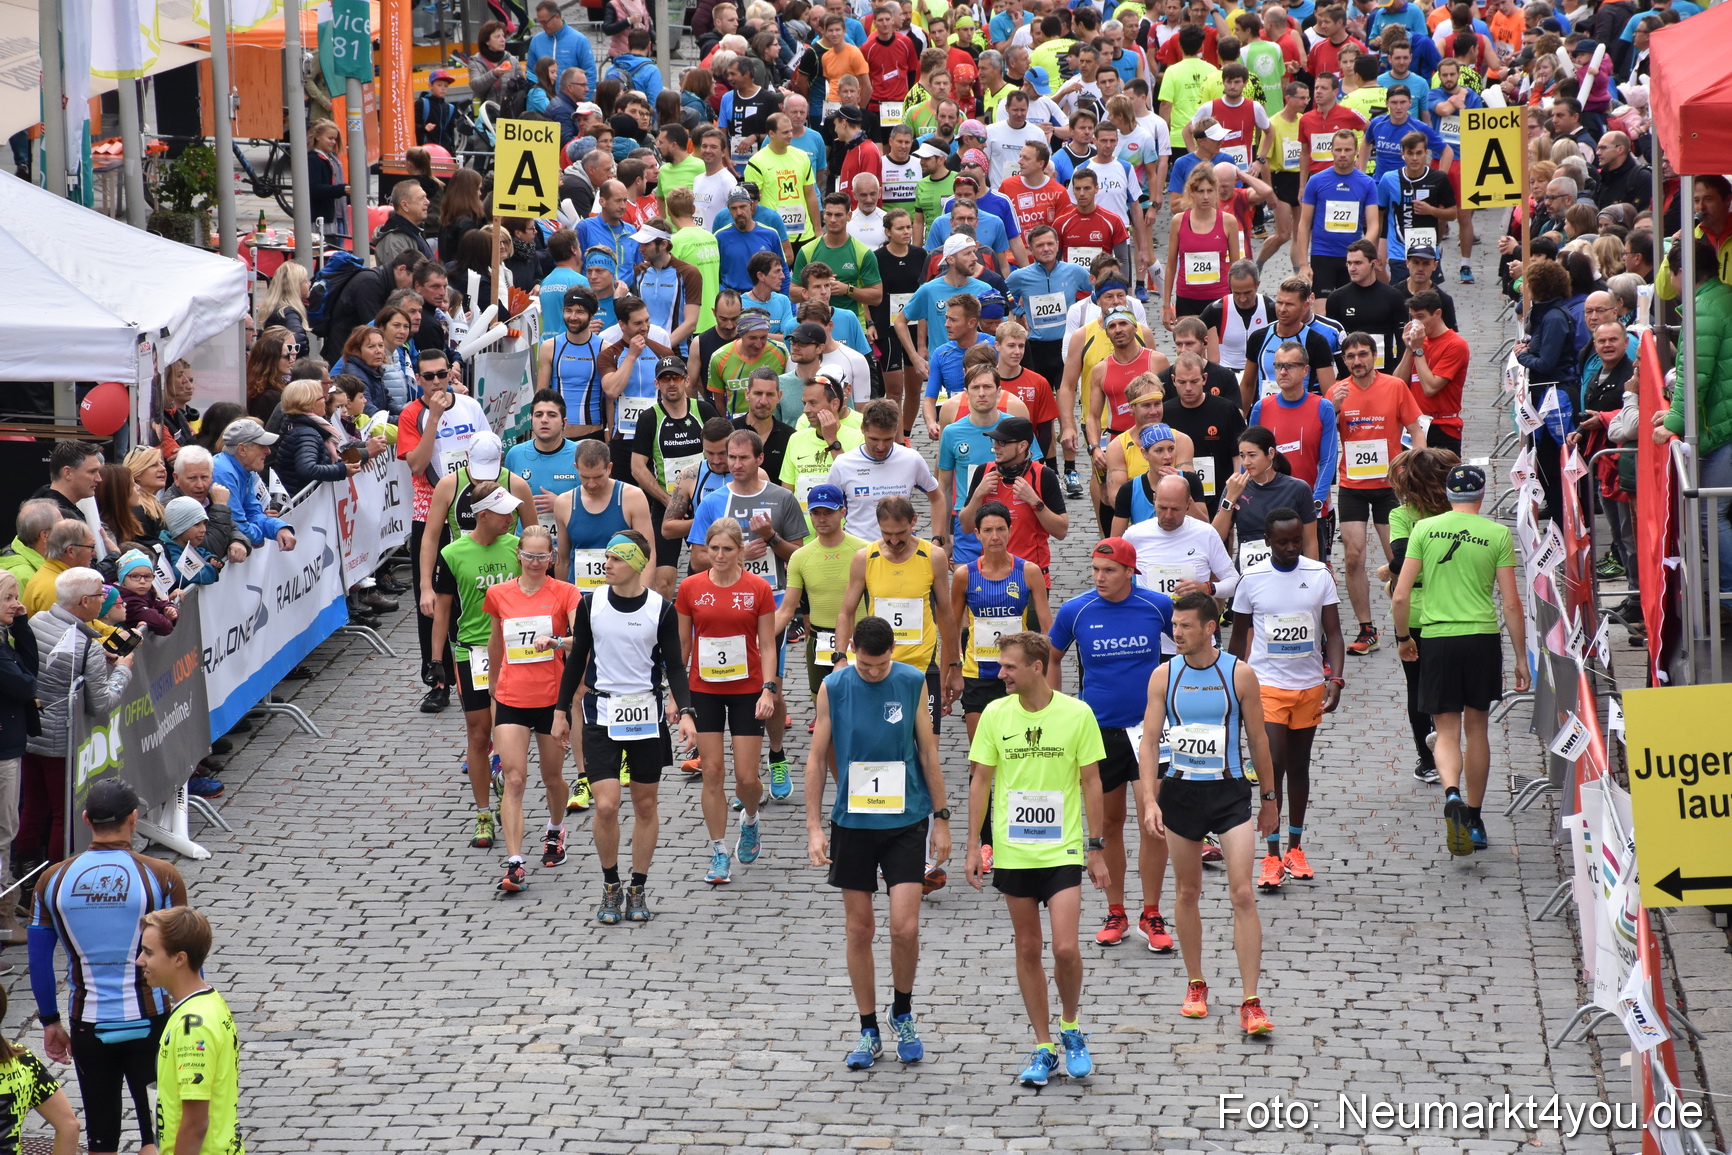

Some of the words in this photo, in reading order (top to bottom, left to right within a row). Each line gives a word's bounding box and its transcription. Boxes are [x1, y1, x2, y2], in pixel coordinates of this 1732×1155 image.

[886, 109, 900, 117] 189
[1467, 110, 1521, 131] Block
[504, 122, 554, 145] Block
[1376, 140, 1402, 149] SYSCA
[1475, 138, 1514, 187] A
[508, 149, 545, 198] A
[782, 213, 802, 225] 2372
[1333, 210, 1351, 221] 227
[1072, 256, 1091, 268] 258
[1193, 261, 1212, 273] 284
[1036, 303, 1062, 316] 2024
[663, 438, 701, 447] Röthenbach
[1355, 451, 1378, 465] 294
[1429, 531, 1490, 547] LAUFMASCHE
[478, 562, 507, 574] FÜRTH
[1158, 578, 1180, 593] 18
[978, 606, 1016, 618] HEITEC
[894, 612, 903, 627] 5
[518, 631, 536, 645] 77
[1272, 626, 1308, 642] 2220
[1092, 635, 1149, 651] SYSCAD
[1281, 644, 1302, 652] Zachary
[717, 651, 727, 665] 3
[711, 667, 736, 676] Stephanie
[615, 706, 649, 722] 2001
[1177, 738, 1217, 755] 2704
[1560, 732, 1578, 755] swn
[1189, 757, 1206, 766] Marco
[872, 777, 879, 793] 1
[867, 798, 886, 806] Stefan
[1677, 788, 1732, 820] lau
[1015, 807, 1056, 824] 2000
[1024, 828, 1046, 836] Michael
[1632, 1001, 1647, 1025] wn
[181, 1013, 203, 1036] P
